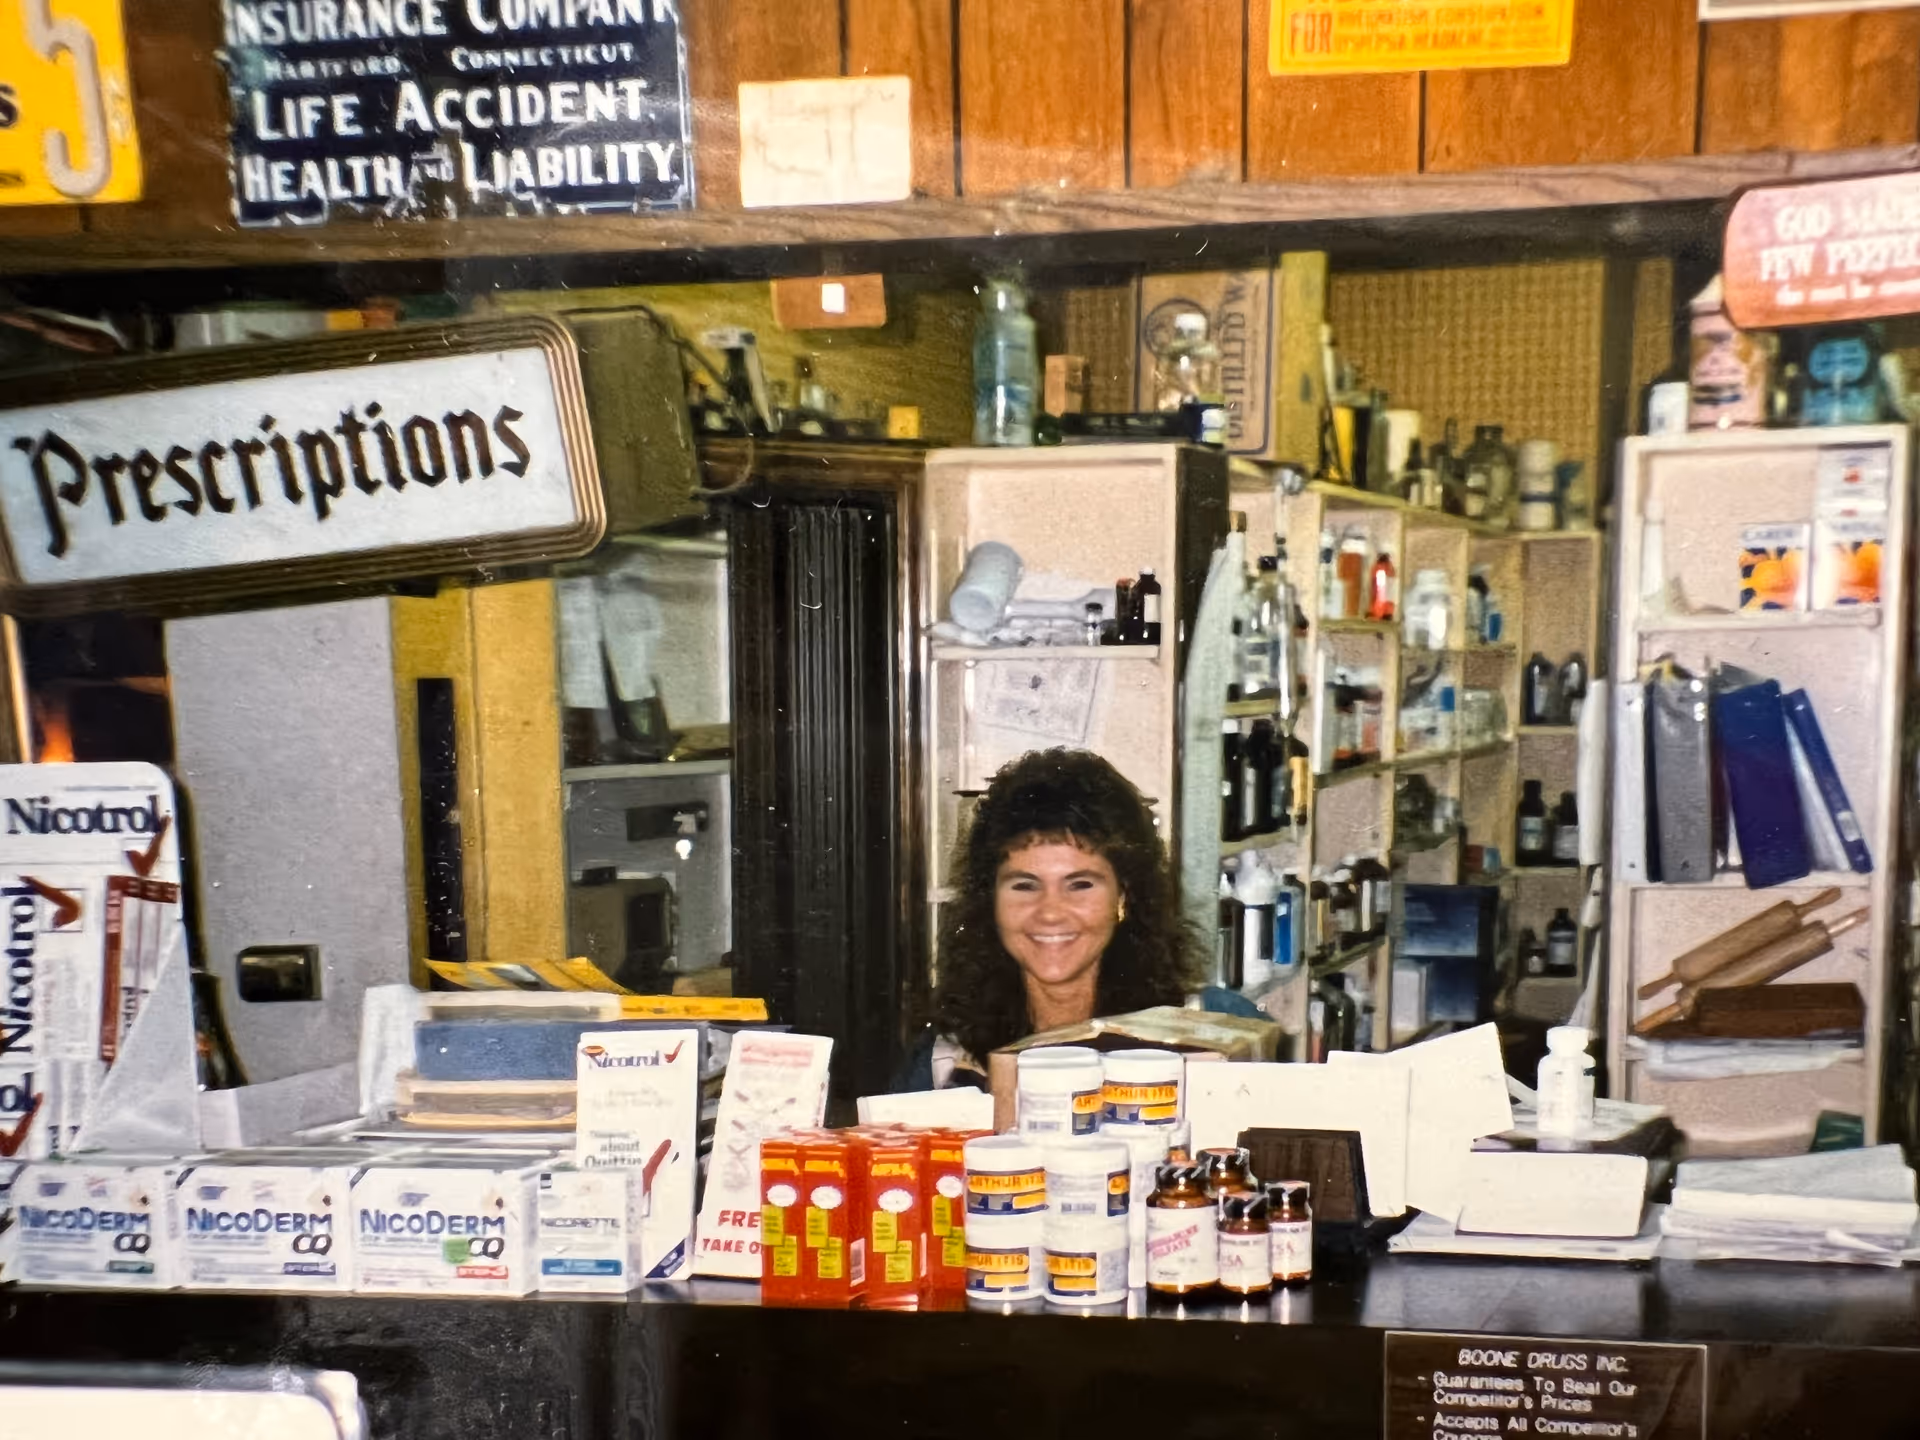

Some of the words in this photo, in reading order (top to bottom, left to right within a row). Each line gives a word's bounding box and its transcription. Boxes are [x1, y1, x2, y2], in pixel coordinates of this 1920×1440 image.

[1290, 9, 1333, 56] FOR
[450, 42, 635, 71] CONNECTICUT
[242, 154, 407, 202] HEALTH
[11, 401, 531, 558] Prescriptions
[7, 795, 161, 835] Nicotrol
[2, 886, 36, 1053] Nicotrol
[588, 1050, 660, 1070] Nicotrol
[186, 1208, 332, 1233] NICODERM
[360, 1209, 505, 1236] NICODERM
[702, 1237, 748, 1254] TAKE
[1458, 1348, 1521, 1368] BOONE
[1526, 1352, 1589, 1371] DRUGS
[1432, 1371, 1525, 1392] Guarantees
[1533, 1376, 1556, 1393] To
[1608, 1381, 1638, 1397] Our
[1540, 1395, 1593, 1413] Prices
[1433, 1411, 1500, 1431] Accepts
[1506, 1416, 1528, 1432] All
